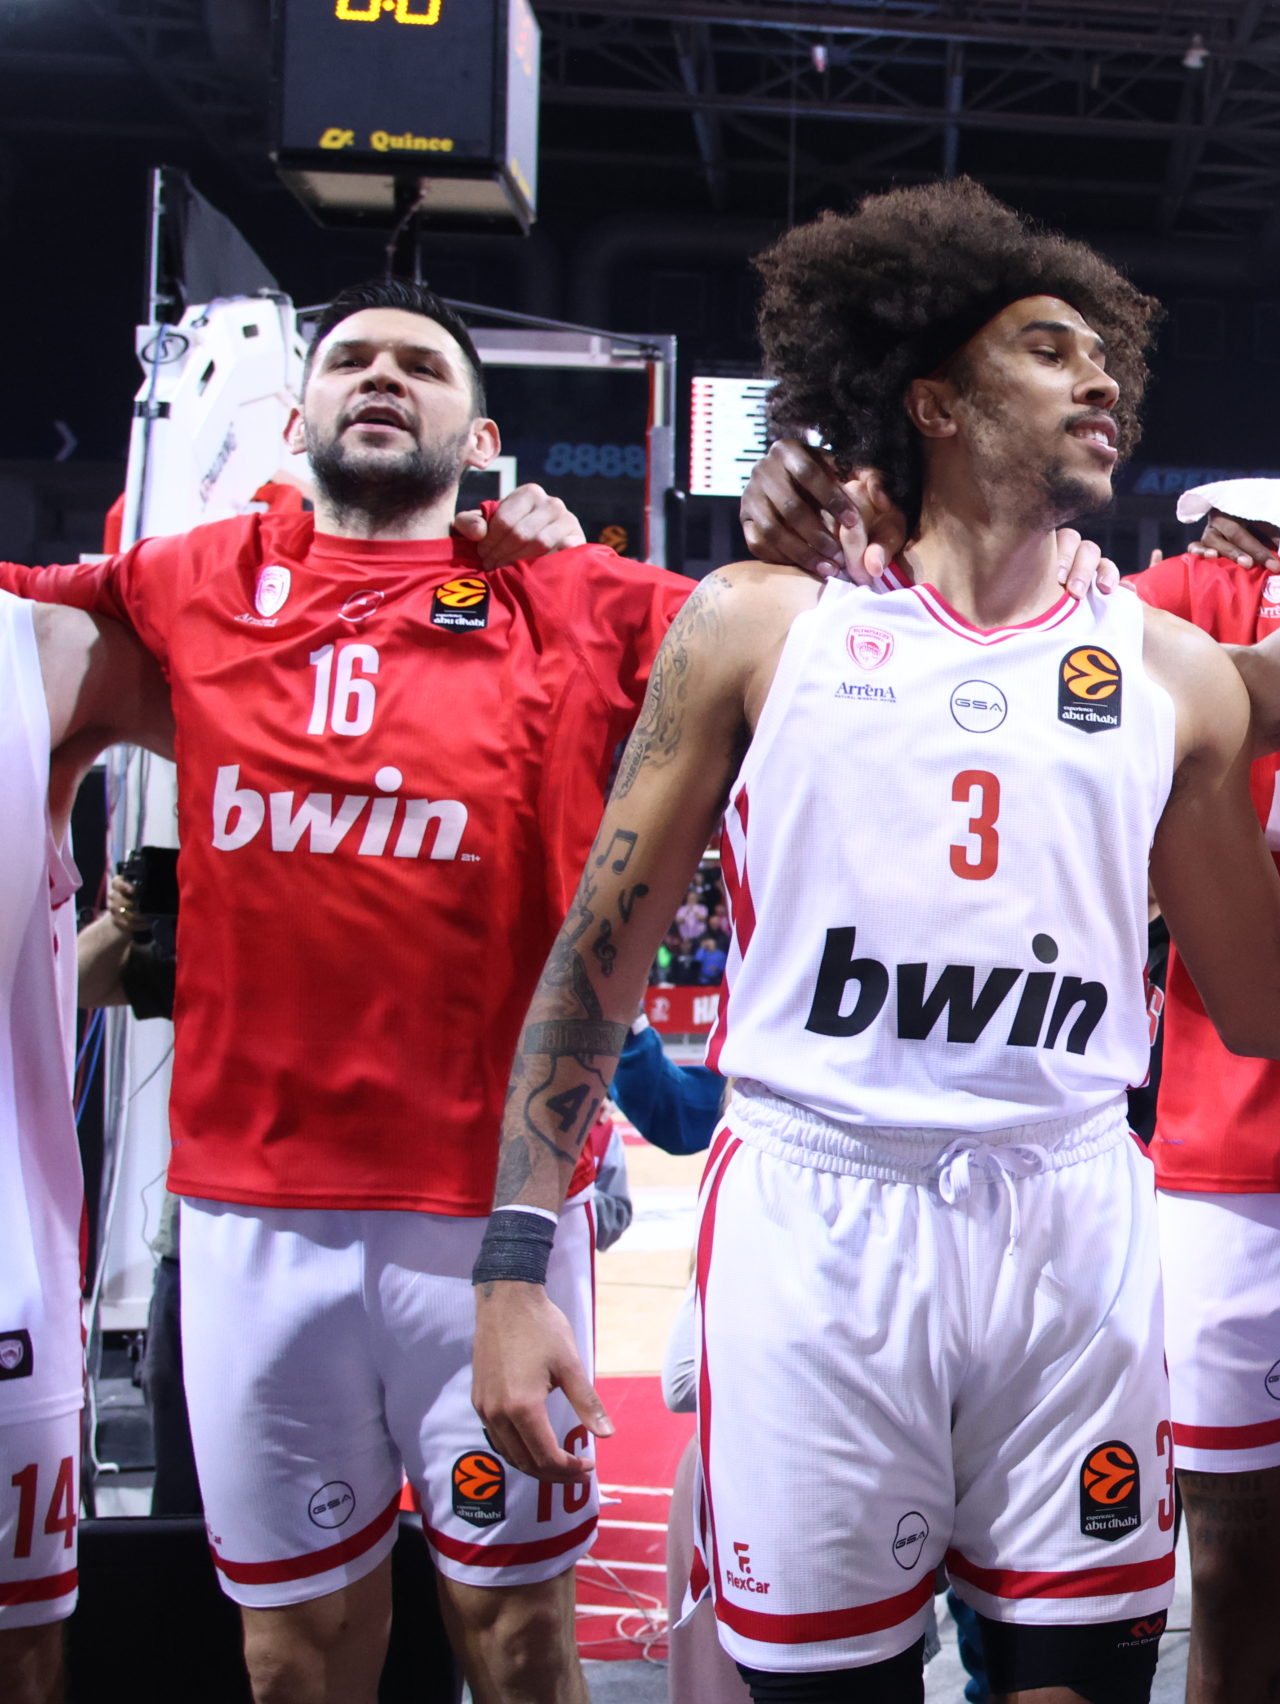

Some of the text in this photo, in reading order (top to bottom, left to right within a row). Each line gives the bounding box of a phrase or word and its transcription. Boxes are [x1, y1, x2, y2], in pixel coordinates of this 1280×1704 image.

[370, 130, 454, 152] Quince
[544, 442, 646, 479] 8888
[307, 644, 380, 736] 16
[955, 698, 1002, 712] GSA
[1062, 711, 1118, 725] abu dhabi
[211, 764, 468, 860] bwin
[950, 769, 1001, 880] 3
[804, 926, 1108, 1056] bwin
[11, 1455, 77, 1559] 14
[312, 1493, 351, 1515] GSA
[1085, 1514, 1138, 1531] abu dhabi
[895, 1530, 926, 1549] GSA
[726, 1570, 770, 1594] FlexCar
